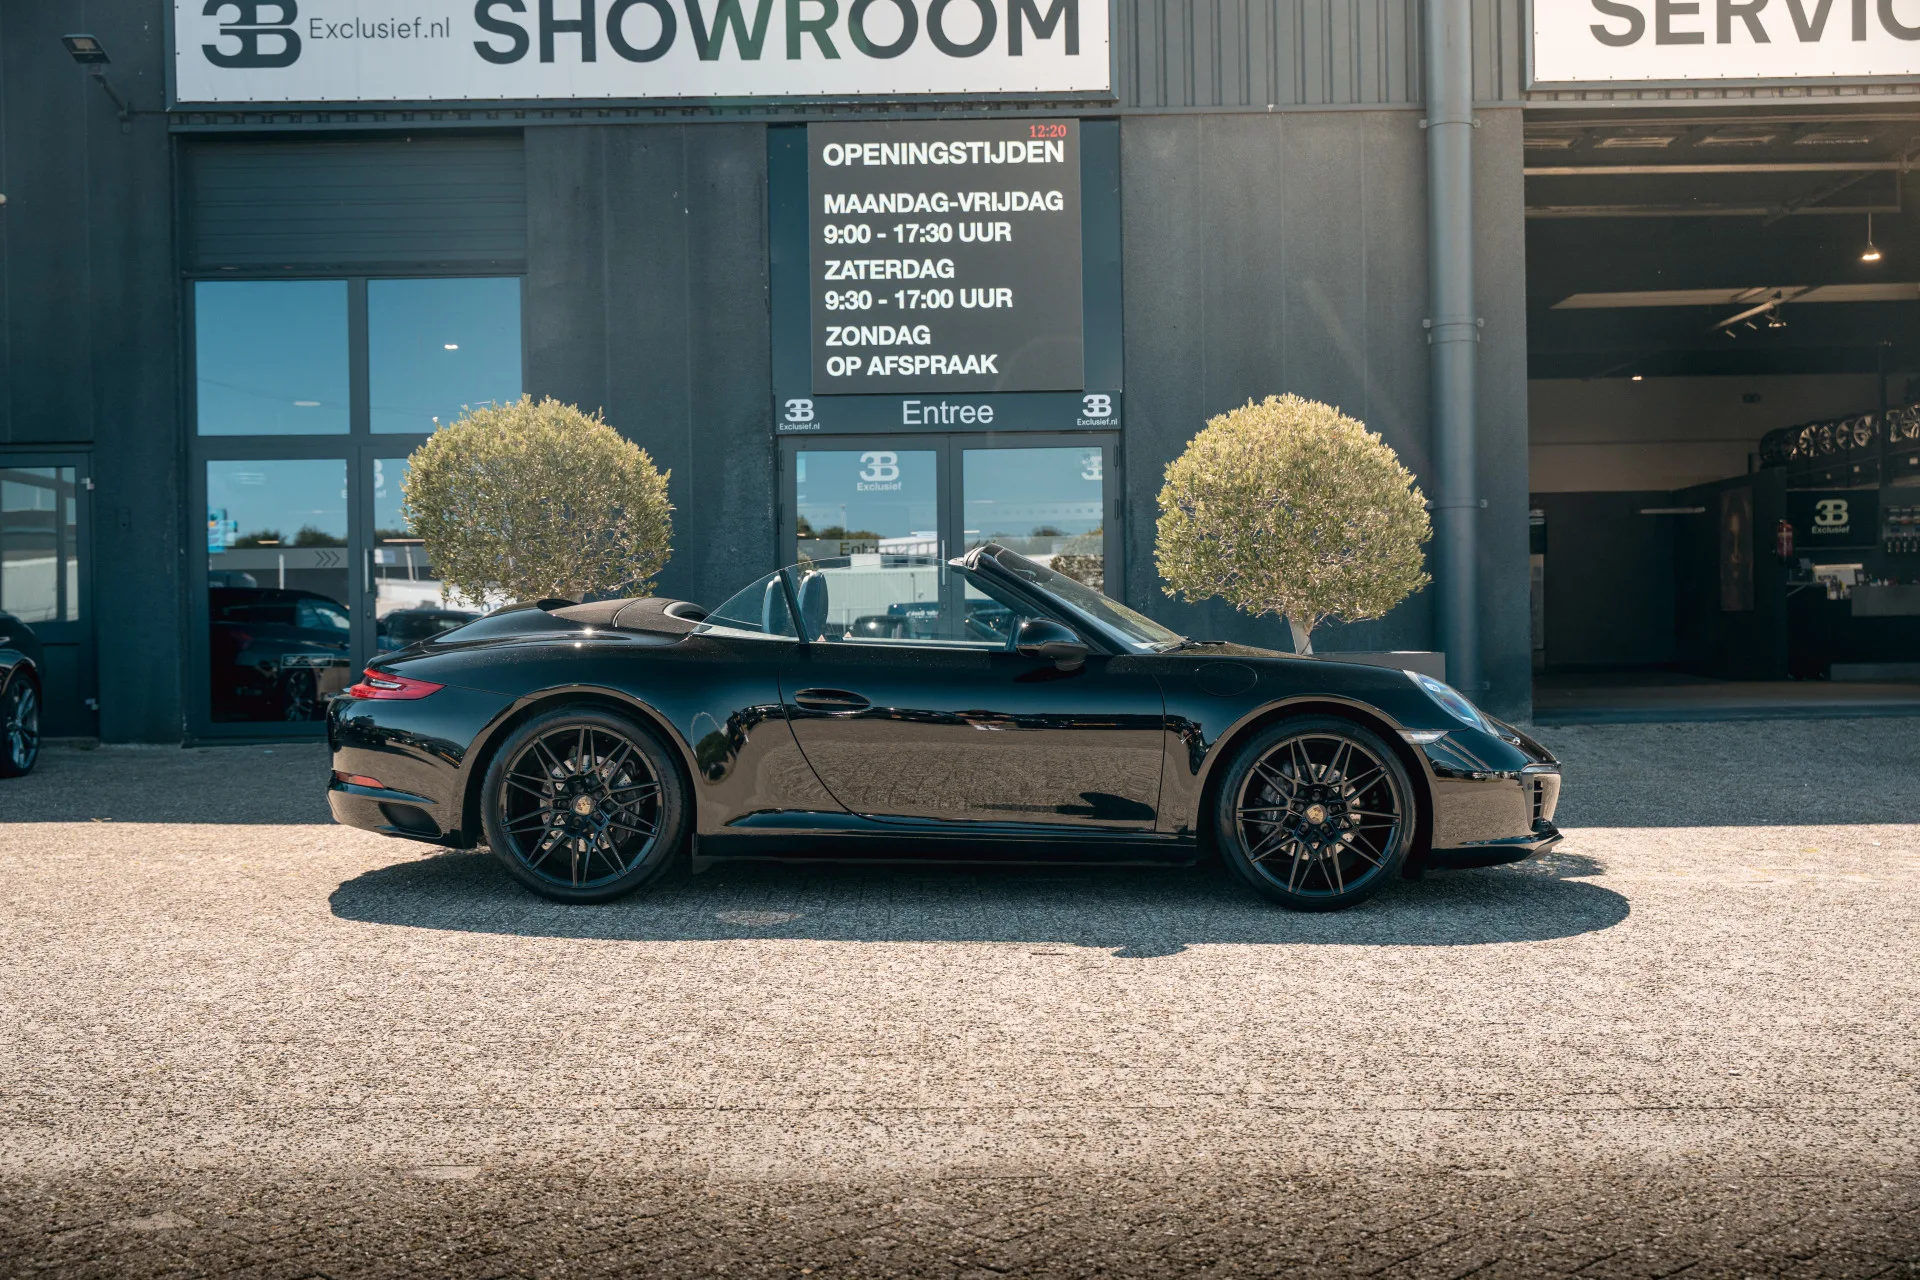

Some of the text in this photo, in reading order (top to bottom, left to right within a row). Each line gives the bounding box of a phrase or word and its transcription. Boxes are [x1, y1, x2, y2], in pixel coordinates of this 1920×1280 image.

[201, 0, 1080, 68] 3B Exclusief.nl SHOWROOM
[1029, 124, 1067, 138] 12:20
[823, 140, 1064, 166] OPENINGSTIJDEN
[824, 191, 1064, 214] MAANDAG-VRIJDAG
[824, 224, 871, 244] 9:00
[893, 223, 953, 243] 17:30
[959, 222, 1012, 242] UUR
[824, 259, 955, 280] ZATERDAG
[825, 290, 872, 310] 9:30
[894, 289, 953, 309] 17:00
[960, 288, 1013, 308] UUR
[826, 325, 931, 346] ZONDAG
[827, 354, 998, 377] OP AFSPRAAK
[784, 399, 814, 421] 3B
[902, 401, 994, 425] Entree
[1082, 394, 1112, 417] 3B
[779, 422, 820, 431] Exclusief.nl
[1076, 418, 1118, 426] Exclusief.nl
[860, 451, 899, 481] 3B
[856, 482, 901, 491] Exclusief
[1814, 499, 1849, 526] 3B
[1811, 525, 1850, 534] Exclusief
